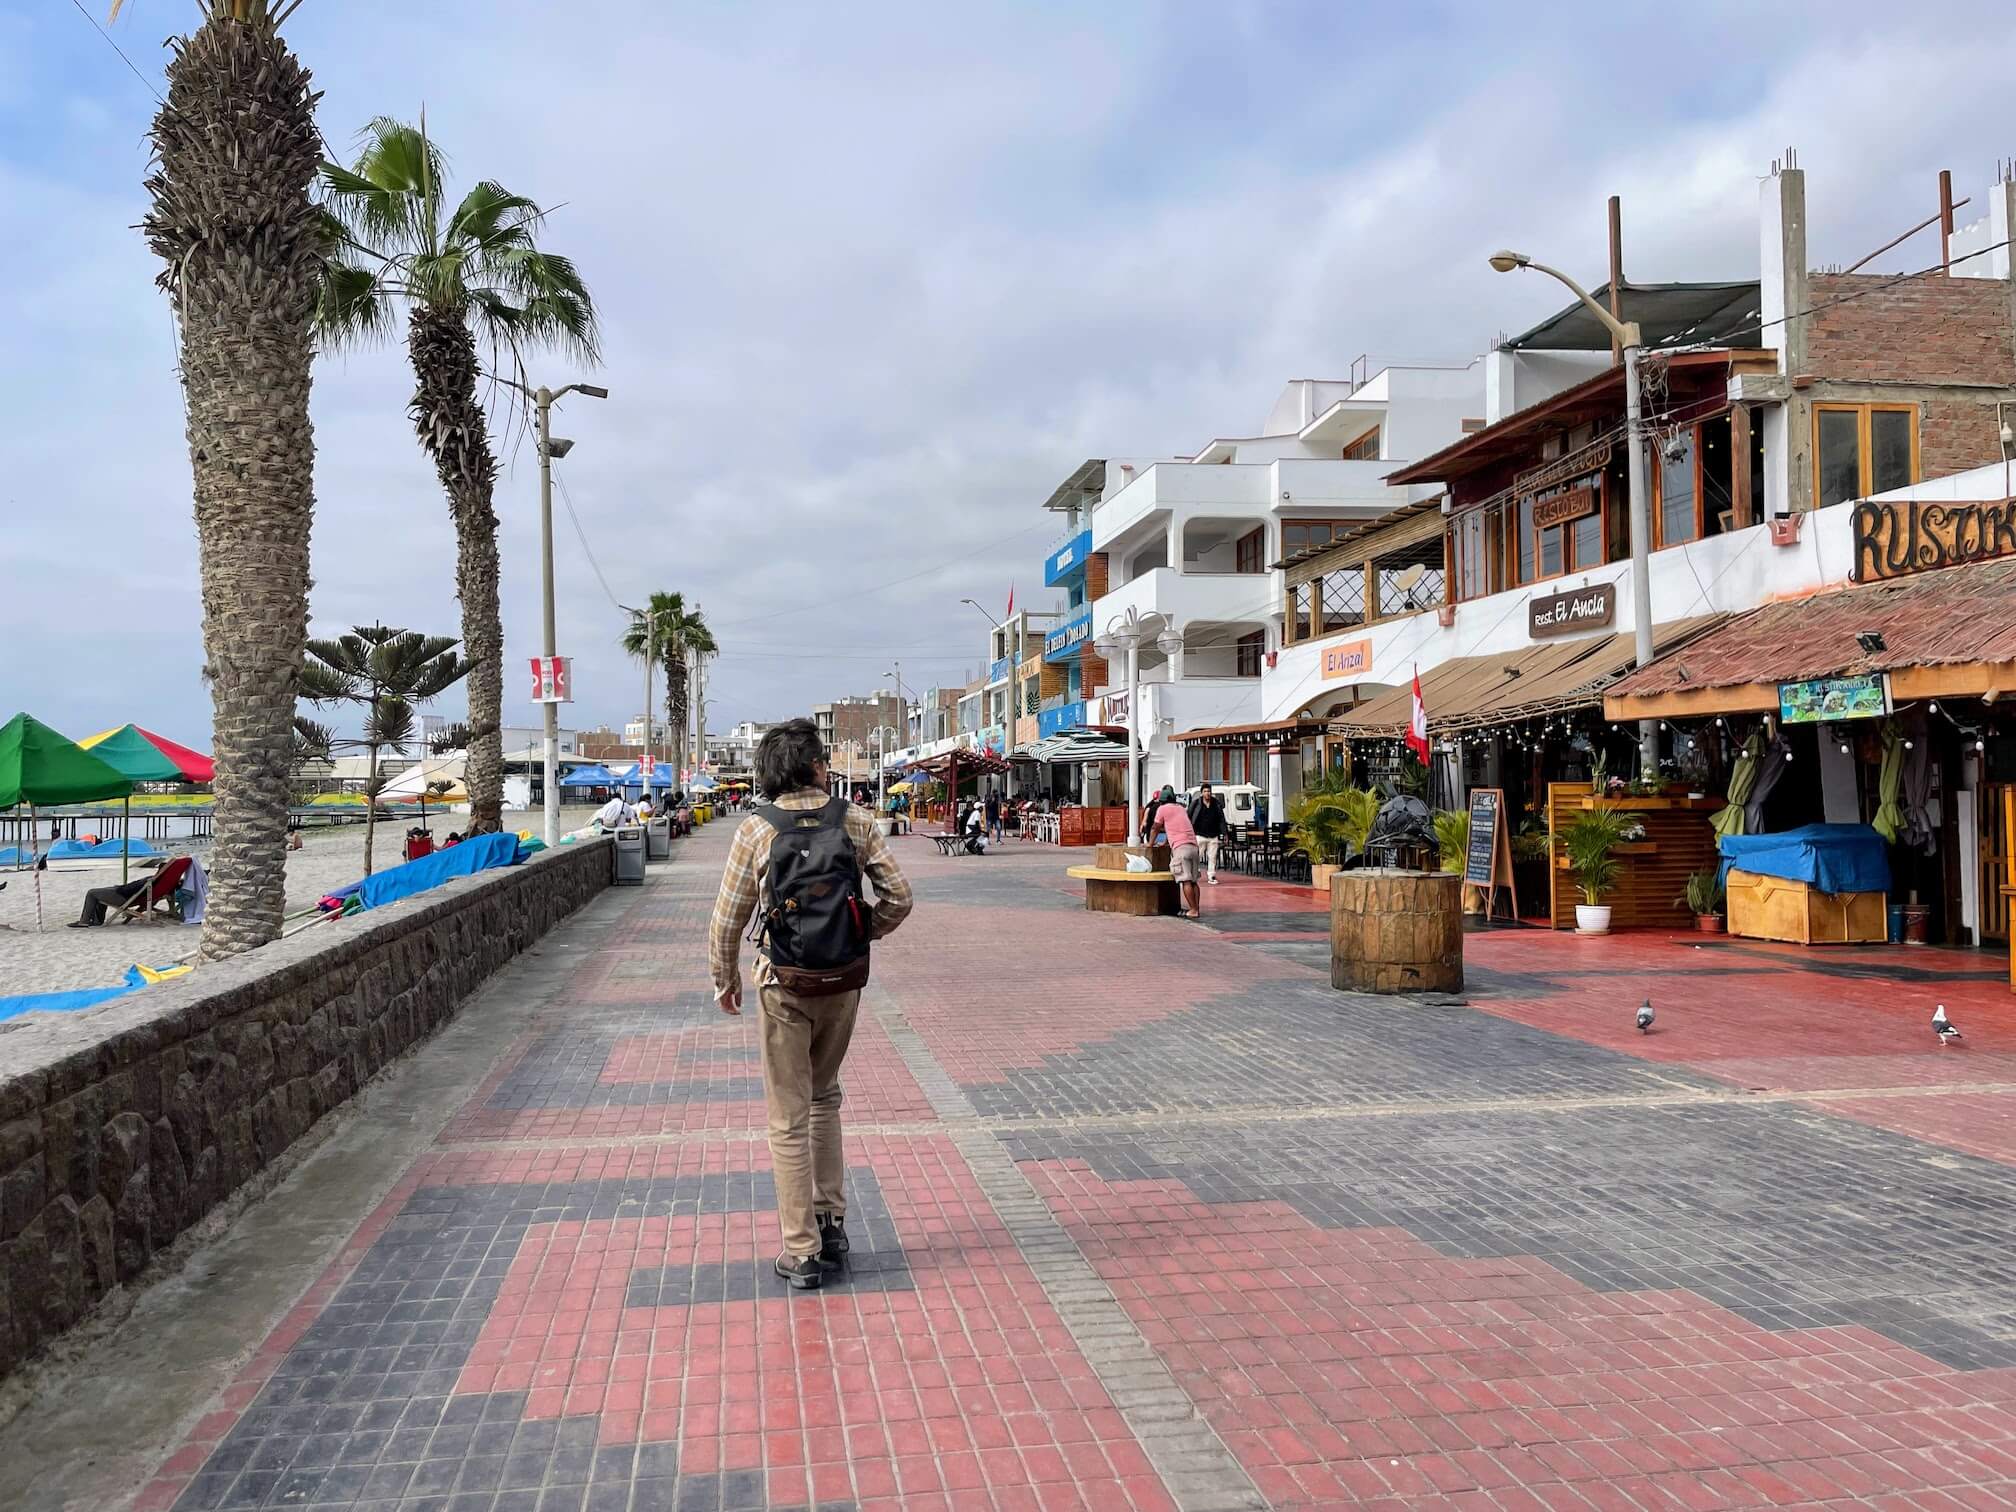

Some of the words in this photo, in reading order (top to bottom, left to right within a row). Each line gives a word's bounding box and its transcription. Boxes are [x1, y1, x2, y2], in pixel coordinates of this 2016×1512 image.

[1556, 600, 1568, 621] El
[1569, 594, 1605, 620] Ancla
[1328, 653, 1336, 672] El
